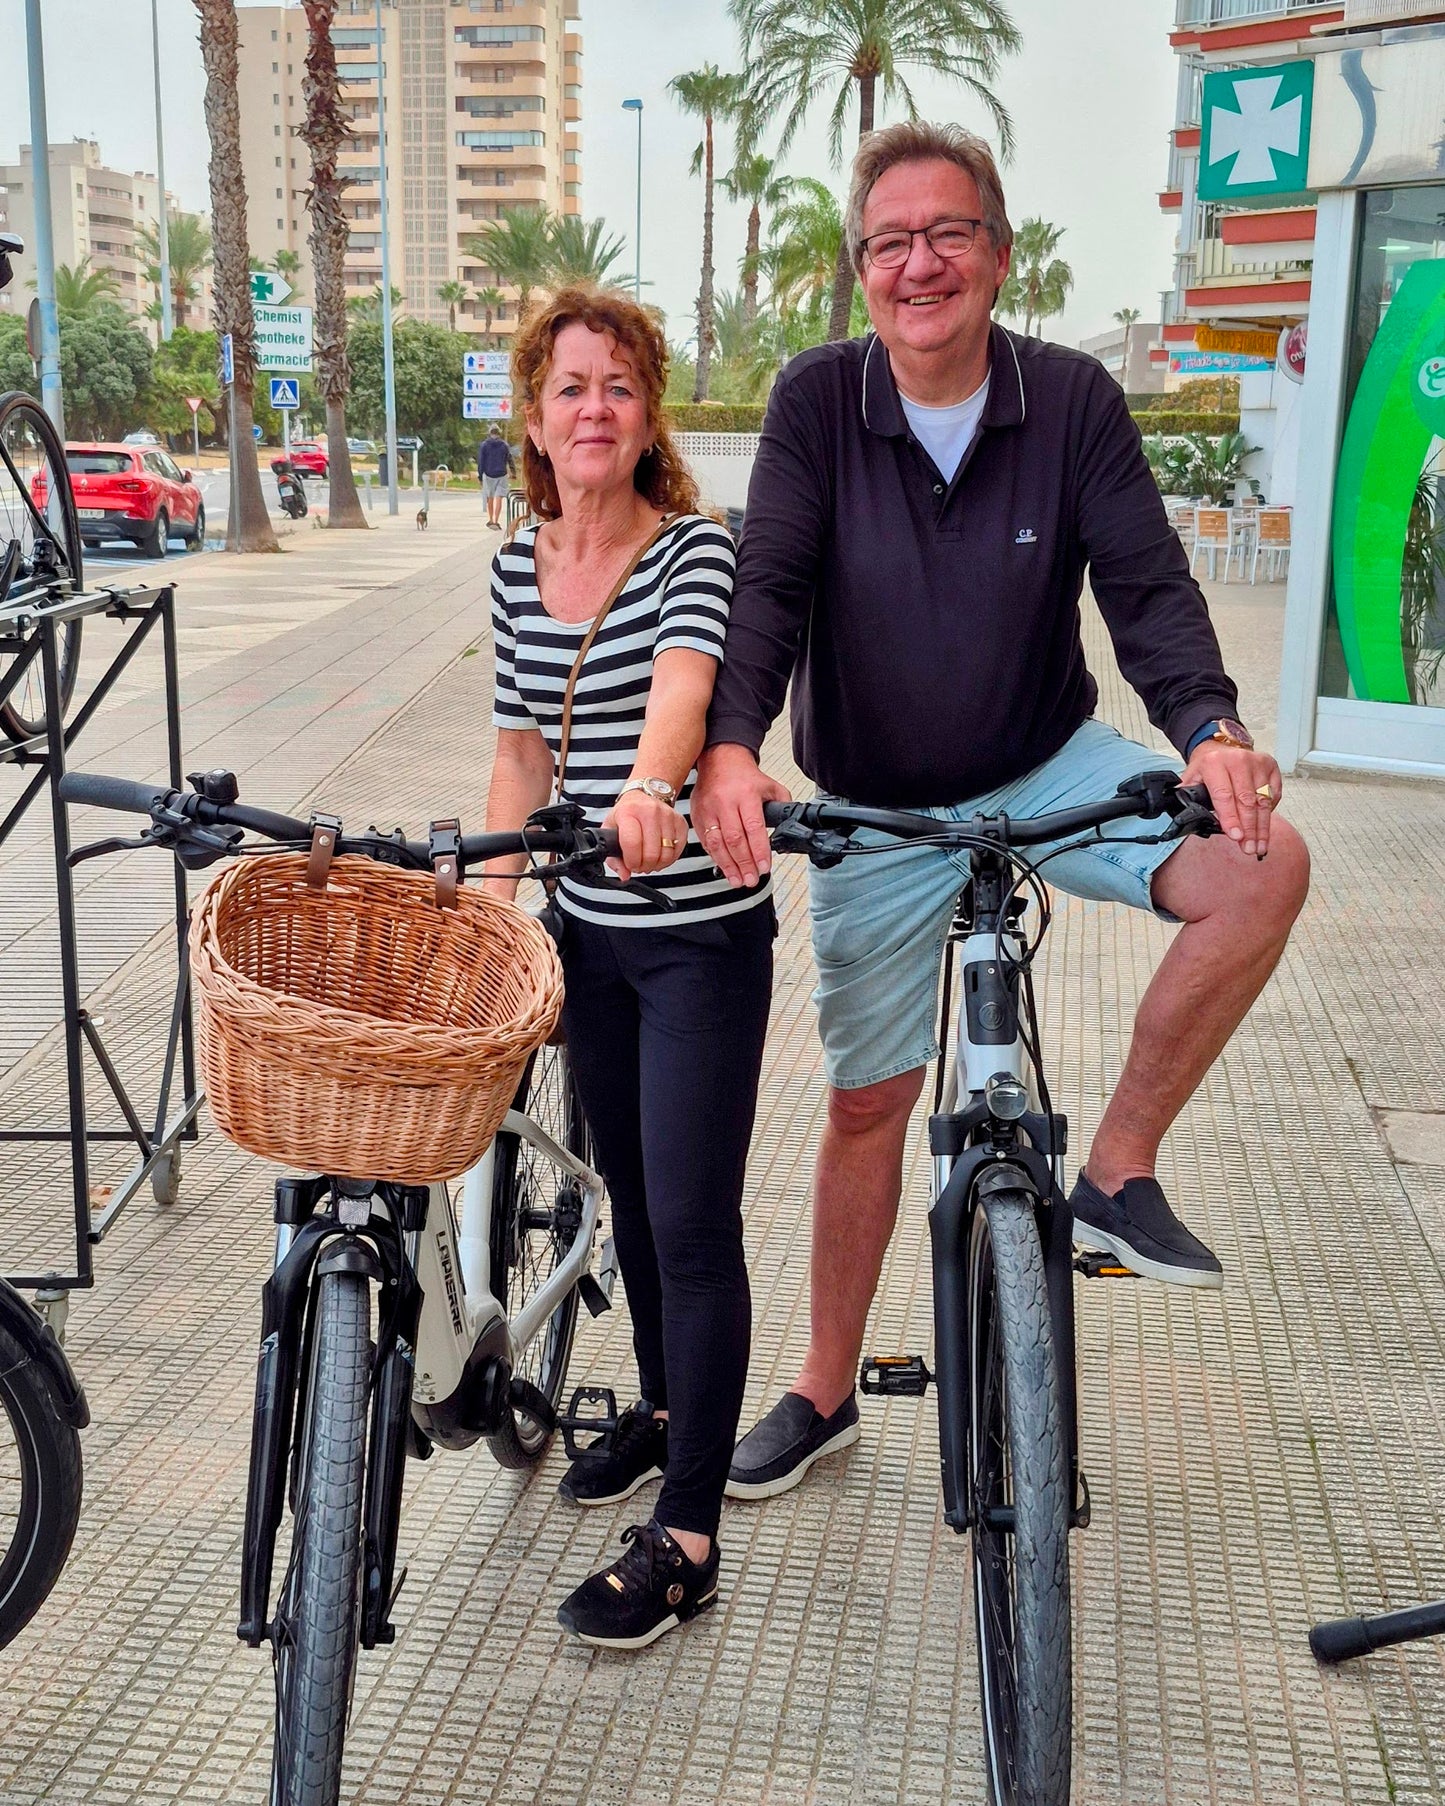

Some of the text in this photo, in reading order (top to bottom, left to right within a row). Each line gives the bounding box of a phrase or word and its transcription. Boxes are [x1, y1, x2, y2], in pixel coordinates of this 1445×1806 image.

[255, 309, 302, 324] Chemist
[257, 352, 309, 366] harmacie
[436, 1230, 463, 1337] LAPIERRE
